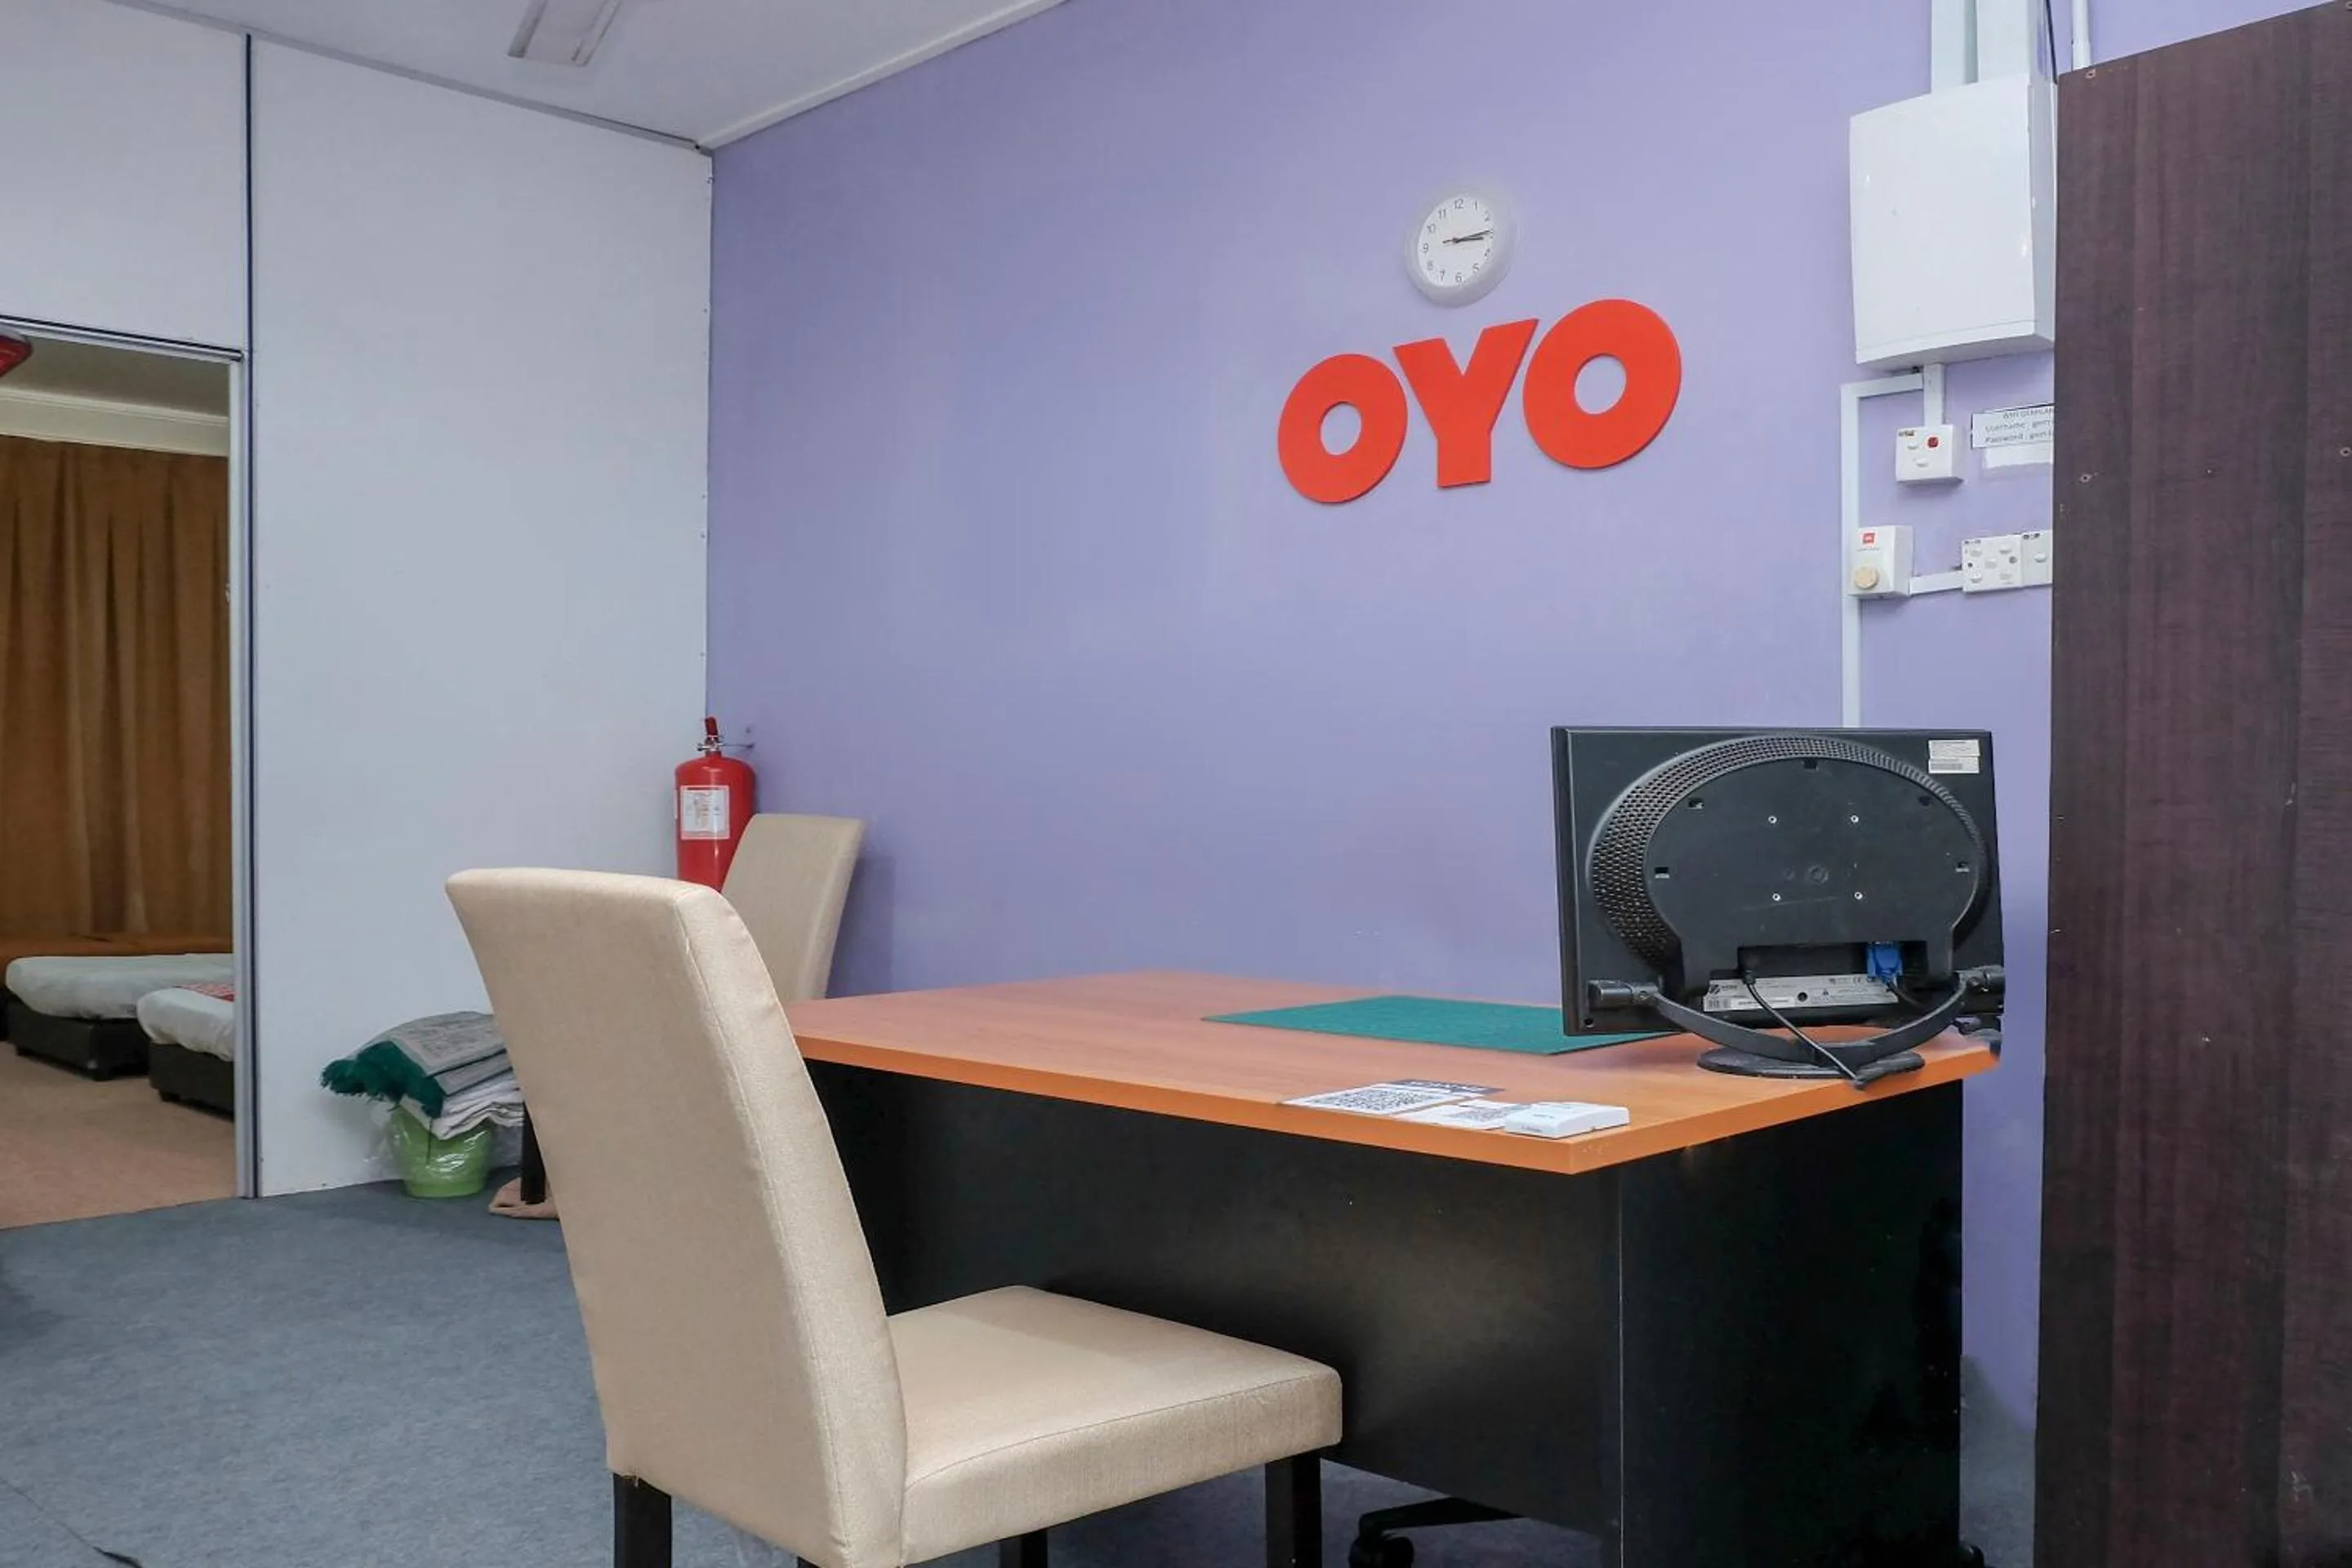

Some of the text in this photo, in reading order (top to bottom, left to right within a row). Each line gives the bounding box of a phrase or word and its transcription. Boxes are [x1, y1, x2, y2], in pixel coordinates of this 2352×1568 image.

[1454, 198, 1464, 209] 12
[1473, 201, 1478, 210] 1
[1438, 209, 1446, 219] 11
[1427, 224, 1437, 234] 10
[1421, 243, 1429, 253] 9
[1472, 263, 1480, 274] 5
[1440, 270, 1446, 281] 7
[1455, 272, 1463, 283] 6
[1277, 298, 1682, 504] OYO
